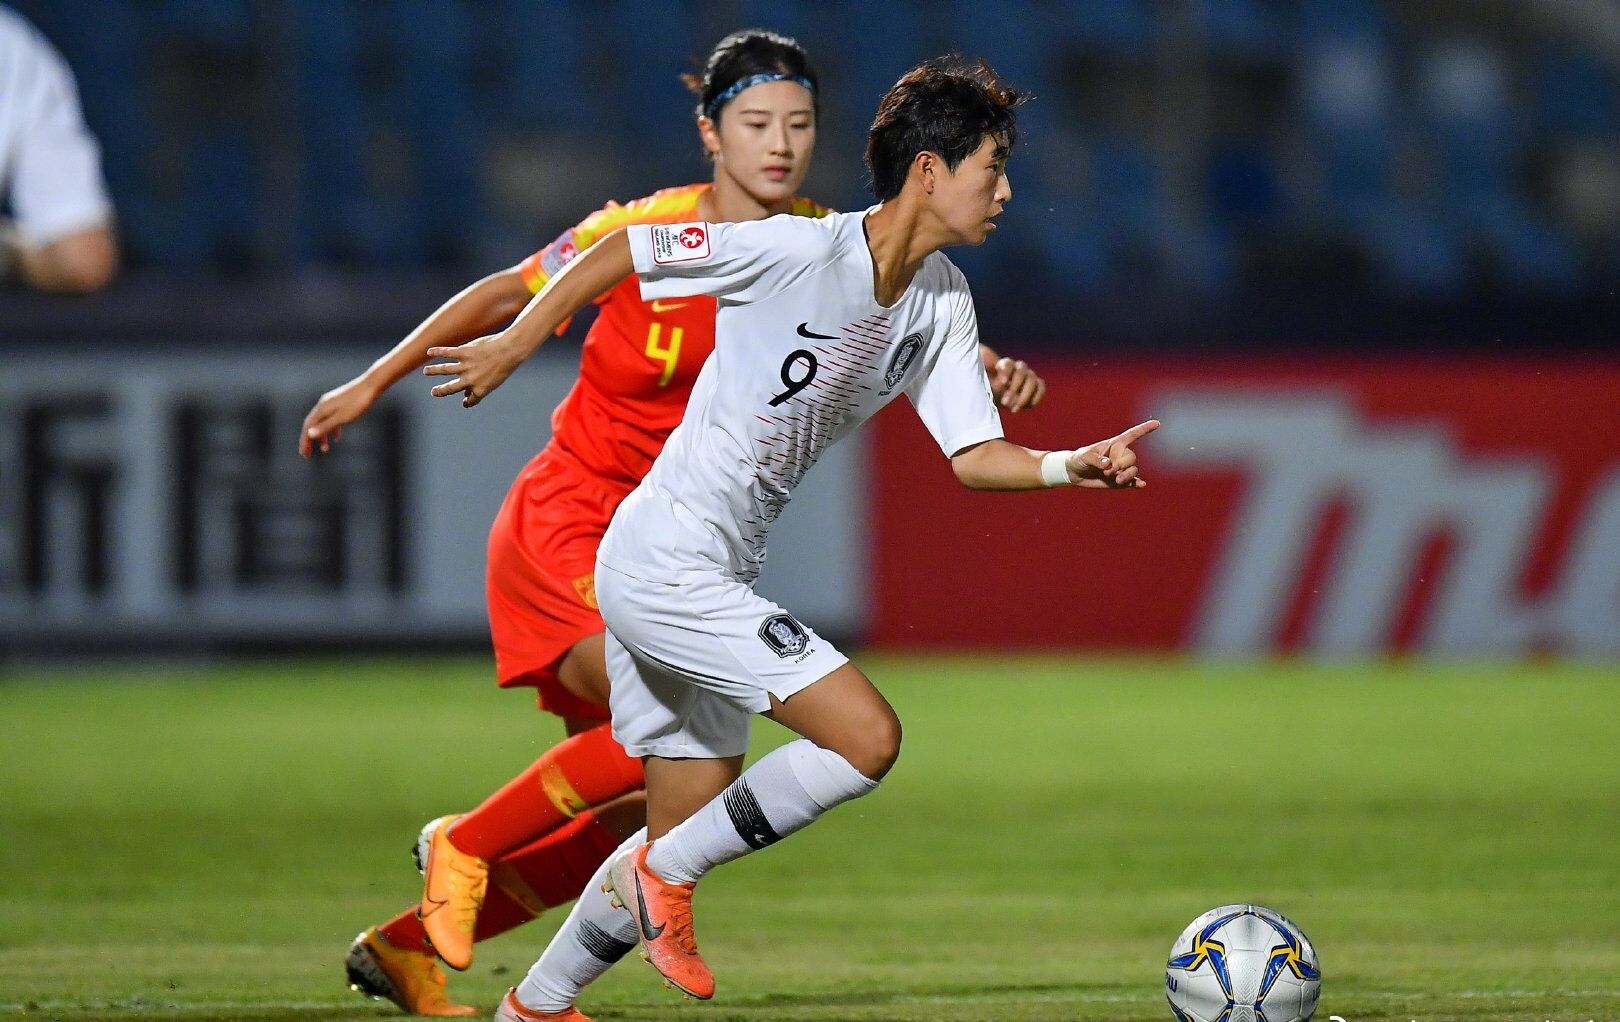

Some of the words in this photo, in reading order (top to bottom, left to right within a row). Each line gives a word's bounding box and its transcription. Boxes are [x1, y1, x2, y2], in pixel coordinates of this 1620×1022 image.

[645, 322, 683, 387] 4
[767, 348, 818, 407] 9
[794, 648, 816, 665] KOREA
